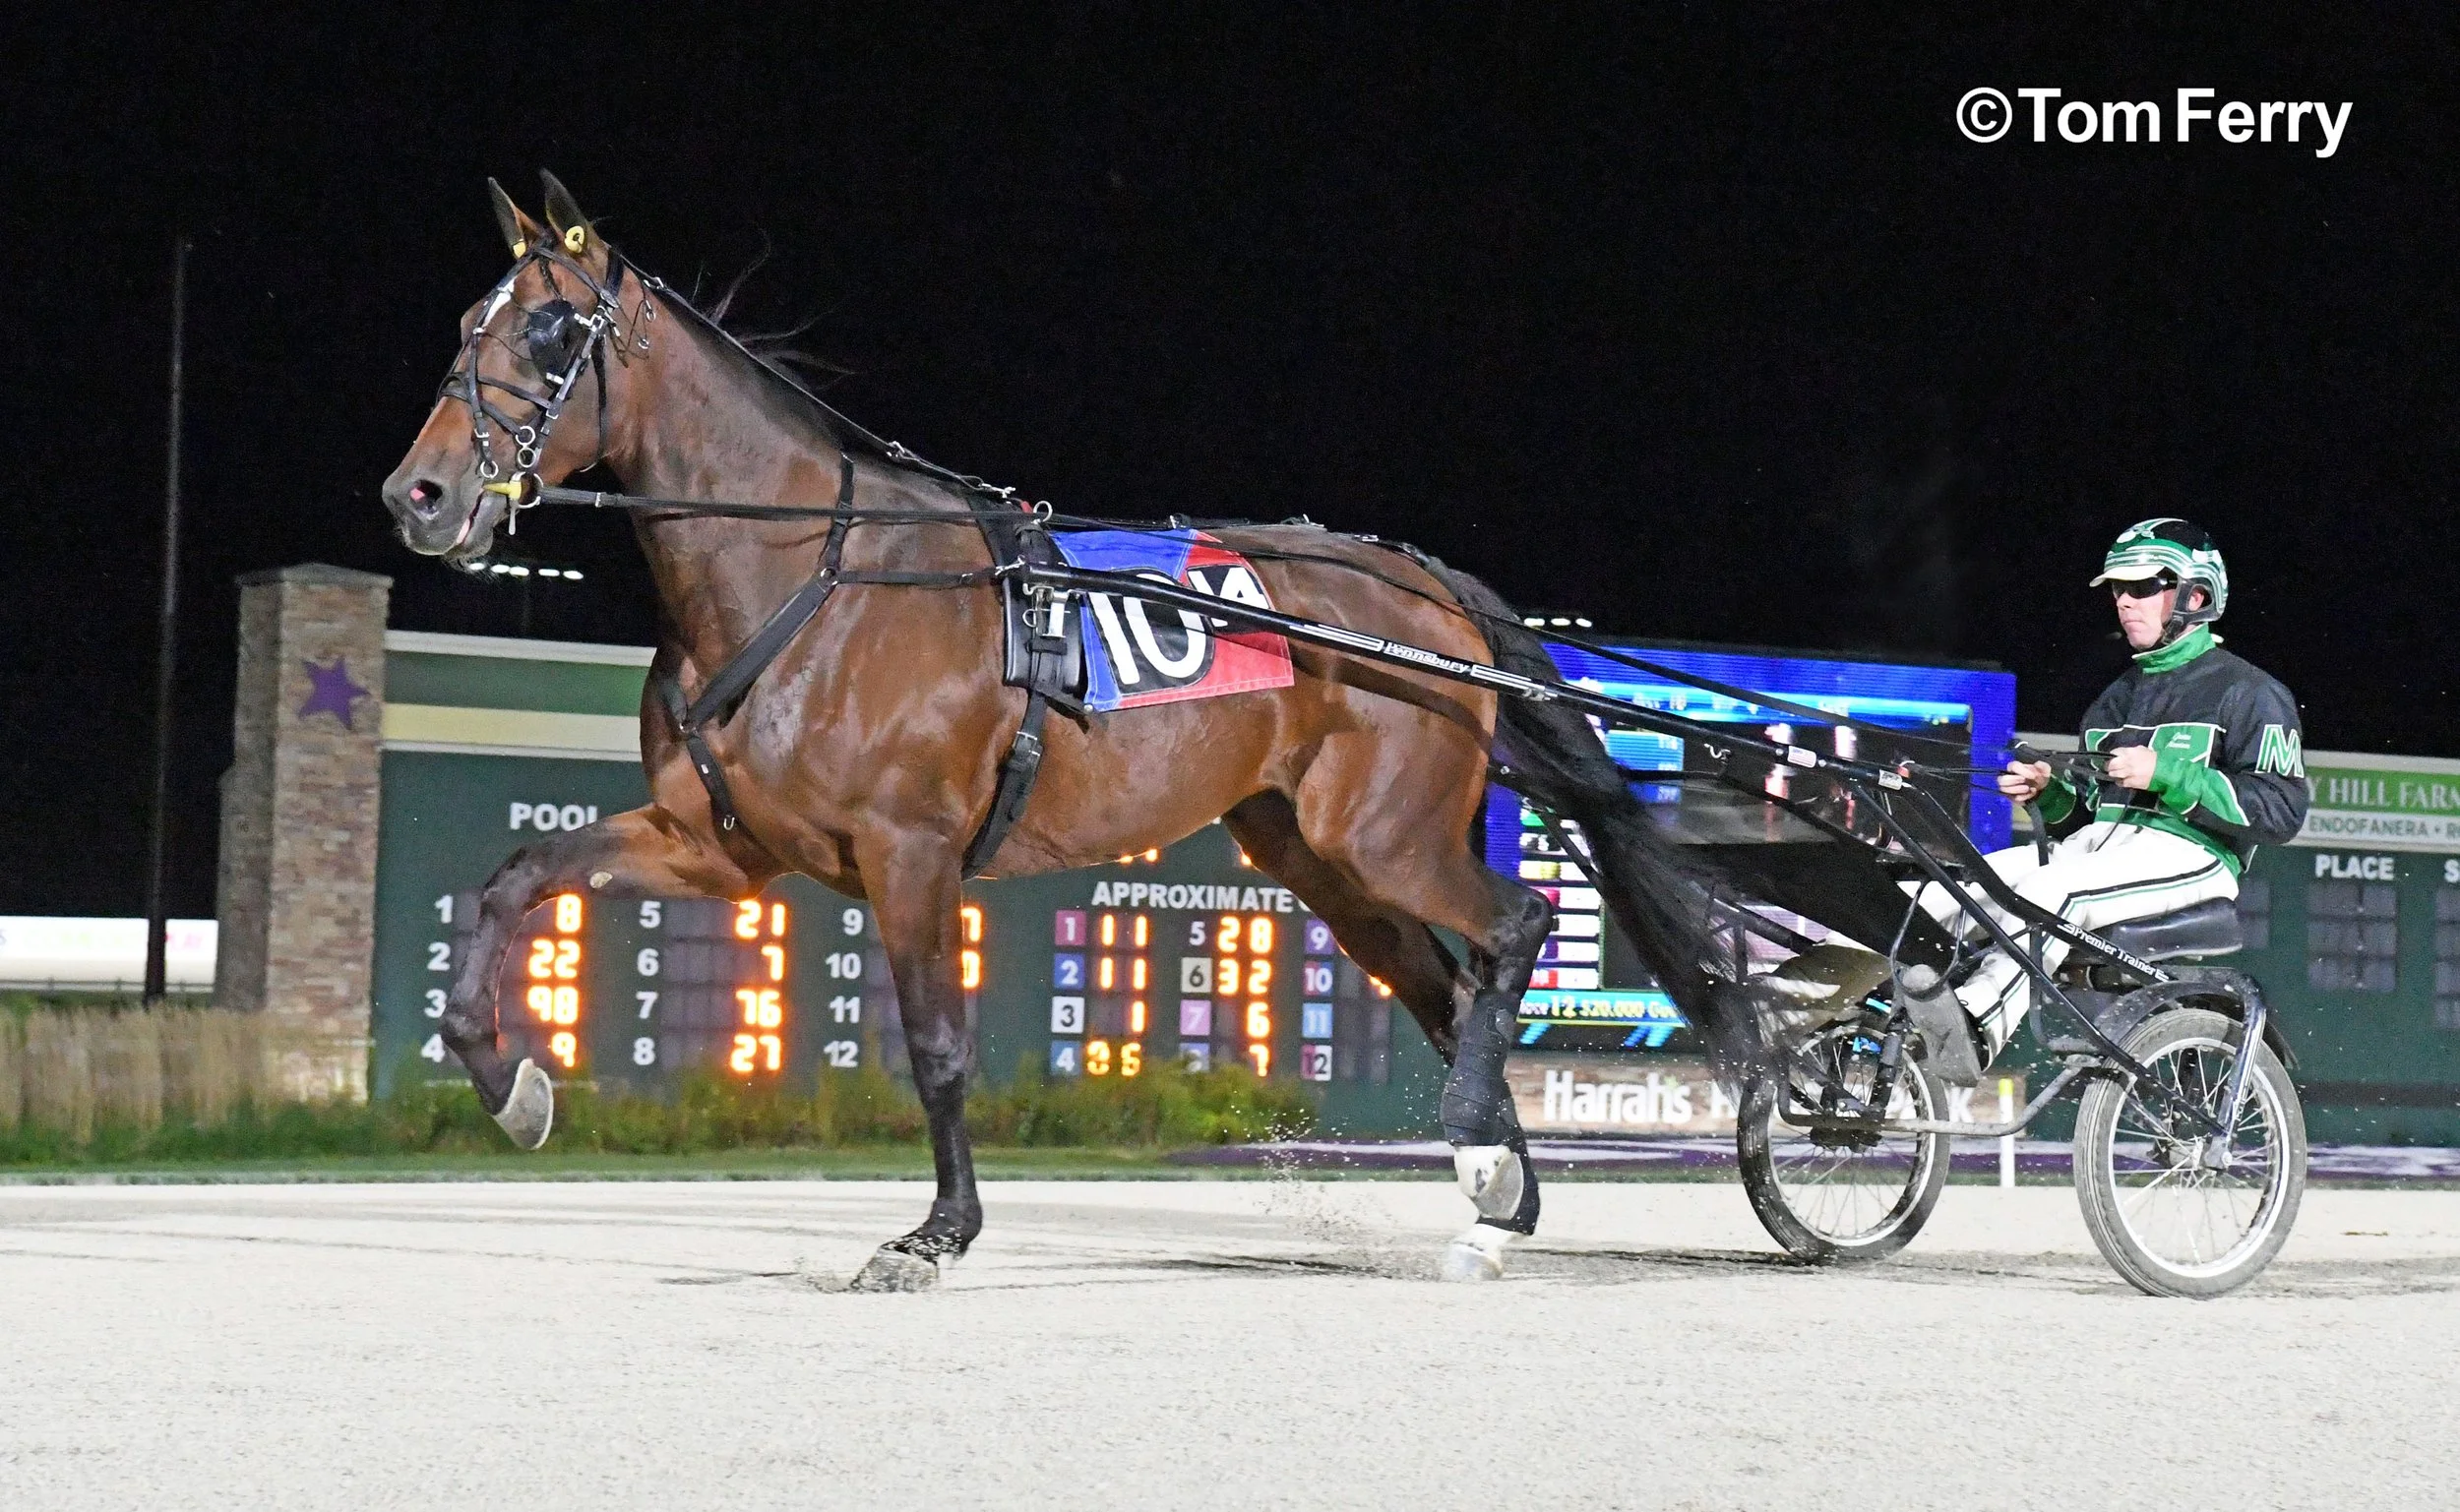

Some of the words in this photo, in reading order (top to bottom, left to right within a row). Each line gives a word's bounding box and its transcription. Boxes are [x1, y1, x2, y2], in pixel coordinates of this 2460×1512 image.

[1384, 641, 1470, 674] Pennsbury
[2254, 724, 2305, 778] M
[2329, 777, 2391, 806] HILL
[2314, 854, 2395, 880] PLACE
[1091, 881, 1294, 914] APPROXIMATE
[434, 894, 453, 924] 1
[556, 893, 582, 933] 8
[640, 901, 660, 929] 5
[842, 908, 863, 936] 9
[1064, 917, 1076, 940] 1
[1189, 921, 1205, 945] 5
[1311, 926, 1328, 950] 9
[427, 941, 451, 971] 2
[528, 939, 580, 979] 22
[638, 948, 658, 976] 6
[762, 945, 784, 981] 7
[2073, 927, 2118, 956] Premier
[2117, 946, 2156, 976] Trainer
[825, 952, 861, 980] 10
[1061, 960, 1078, 985] 2
[1189, 965, 1204, 988] 6
[1305, 967, 1333, 993] 10
[424, 988, 448, 1018] 3
[636, 992, 658, 1019] 7
[736, 990, 781, 1027] 76
[830, 996, 860, 1023] 11
[1060, 1004, 1075, 1027] 3
[1132, 1000, 1145, 1033] 1
[1189, 1007, 1205, 1026] 7
[1247, 1001, 1269, 1038] 6
[1309, 1011, 1327, 1030] 11
[421, 1033, 445, 1063] 4
[551, 1032, 577, 1068] 9
[634, 1038, 655, 1066] 8
[730, 1034, 781, 1072] 27
[824, 1040, 858, 1067] 12
[1056, 1048, 1076, 1072] 4
[1304, 1053, 1327, 1075] 12
